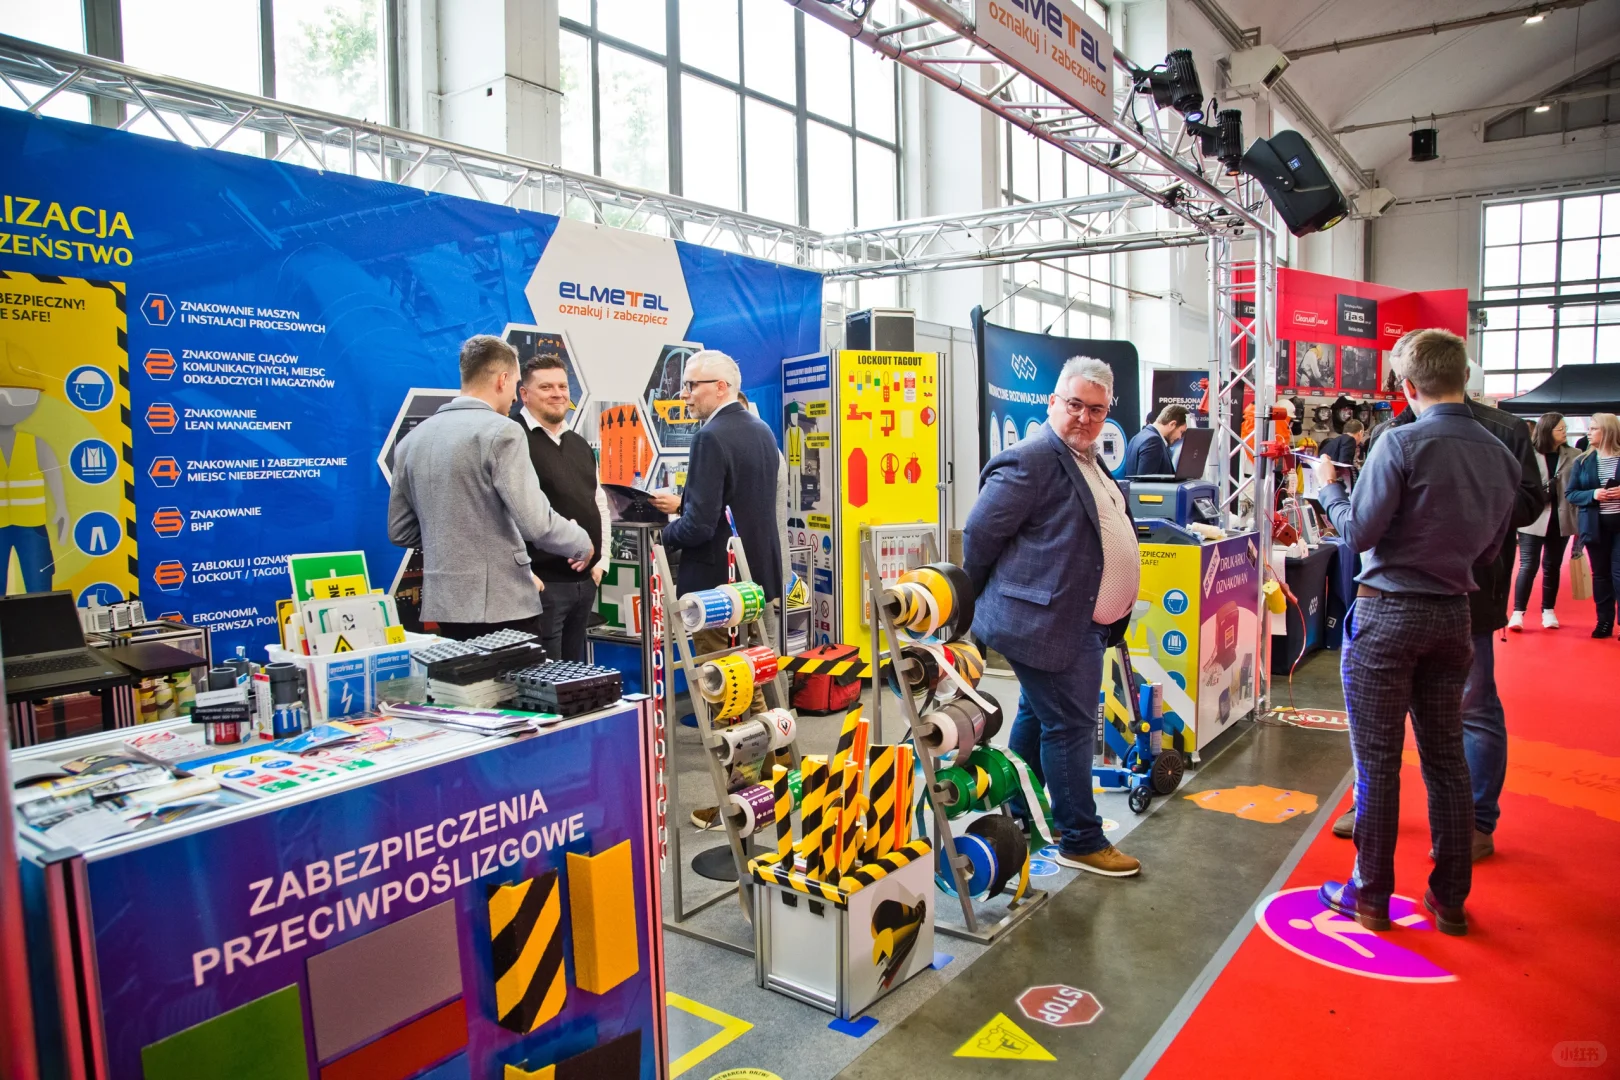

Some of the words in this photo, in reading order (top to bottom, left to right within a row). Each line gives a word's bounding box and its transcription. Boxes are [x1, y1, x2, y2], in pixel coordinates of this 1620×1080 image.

[989, 1, 1040, 54] oznakuj
[1044, 34, 1047, 55] i
[1051, 44, 1107, 97] zabezpiecz
[0, 195, 134, 240] IZACJA
[0, 233, 133, 267] ZEŃSTWO
[12, 309, 51, 322] SAFE!
[180, 301, 254, 317] ZNAKOWANIE
[257, 308, 300, 320] MASZYN
[559, 303, 603, 320] oznakuj
[606, 308, 610, 319] i
[613, 310, 668, 325] zabezpiecz
[181, 314, 185, 323] I
[188, 314, 247, 328] INSTALACJI
[249, 319, 326, 334] PROCESOWYCH
[182, 349, 256, 362] ZNAKOWANIE
[258, 352, 299, 365] CIĄGÓW
[857, 355, 892, 366] LOCKOUT
[893, 356, 923, 367] TAGOUT
[183, 361, 289, 376] KOMUNIKACYJNYCH,
[291, 367, 326, 378] MIEJSC
[183, 374, 263, 386] ODKŁADCZYCH
[265, 377, 269, 386] I
[271, 377, 335, 389] MAGAZYNÓW
[1159, 396, 1202, 404] PROFESJONA
[184, 408, 257, 419] ZNAKOWANIE
[185, 420, 214, 431] LEAN
[216, 421, 293, 431] MANAGEMENT
[186, 459, 259, 470] ZNAKOWANIE
[261, 459, 265, 468] I
[267, 457, 348, 469] ZABEZPIECZANIE
[187, 471, 226, 482] MIEJSC
[228, 469, 321, 481] NIEBEZPIECZNYCH
[190, 506, 262, 520] ZNAKOWANIE
[191, 522, 214, 532] BHP
[191, 558, 245, 572] ZABLOKUJ
[247, 557, 251, 567] I
[1219, 552, 1246, 572] DRUKARKI
[192, 571, 242, 584] LOCKOUT
[192, 607, 259, 624] ERGONOMIA
[201, 619, 254, 634] IERWSZA
[248, 788, 549, 917] ZABEZPIECZENIA
[192, 811, 587, 988] PRZECIWPOŚLIZGOWE
[1037, 987, 1083, 1024] STOP
